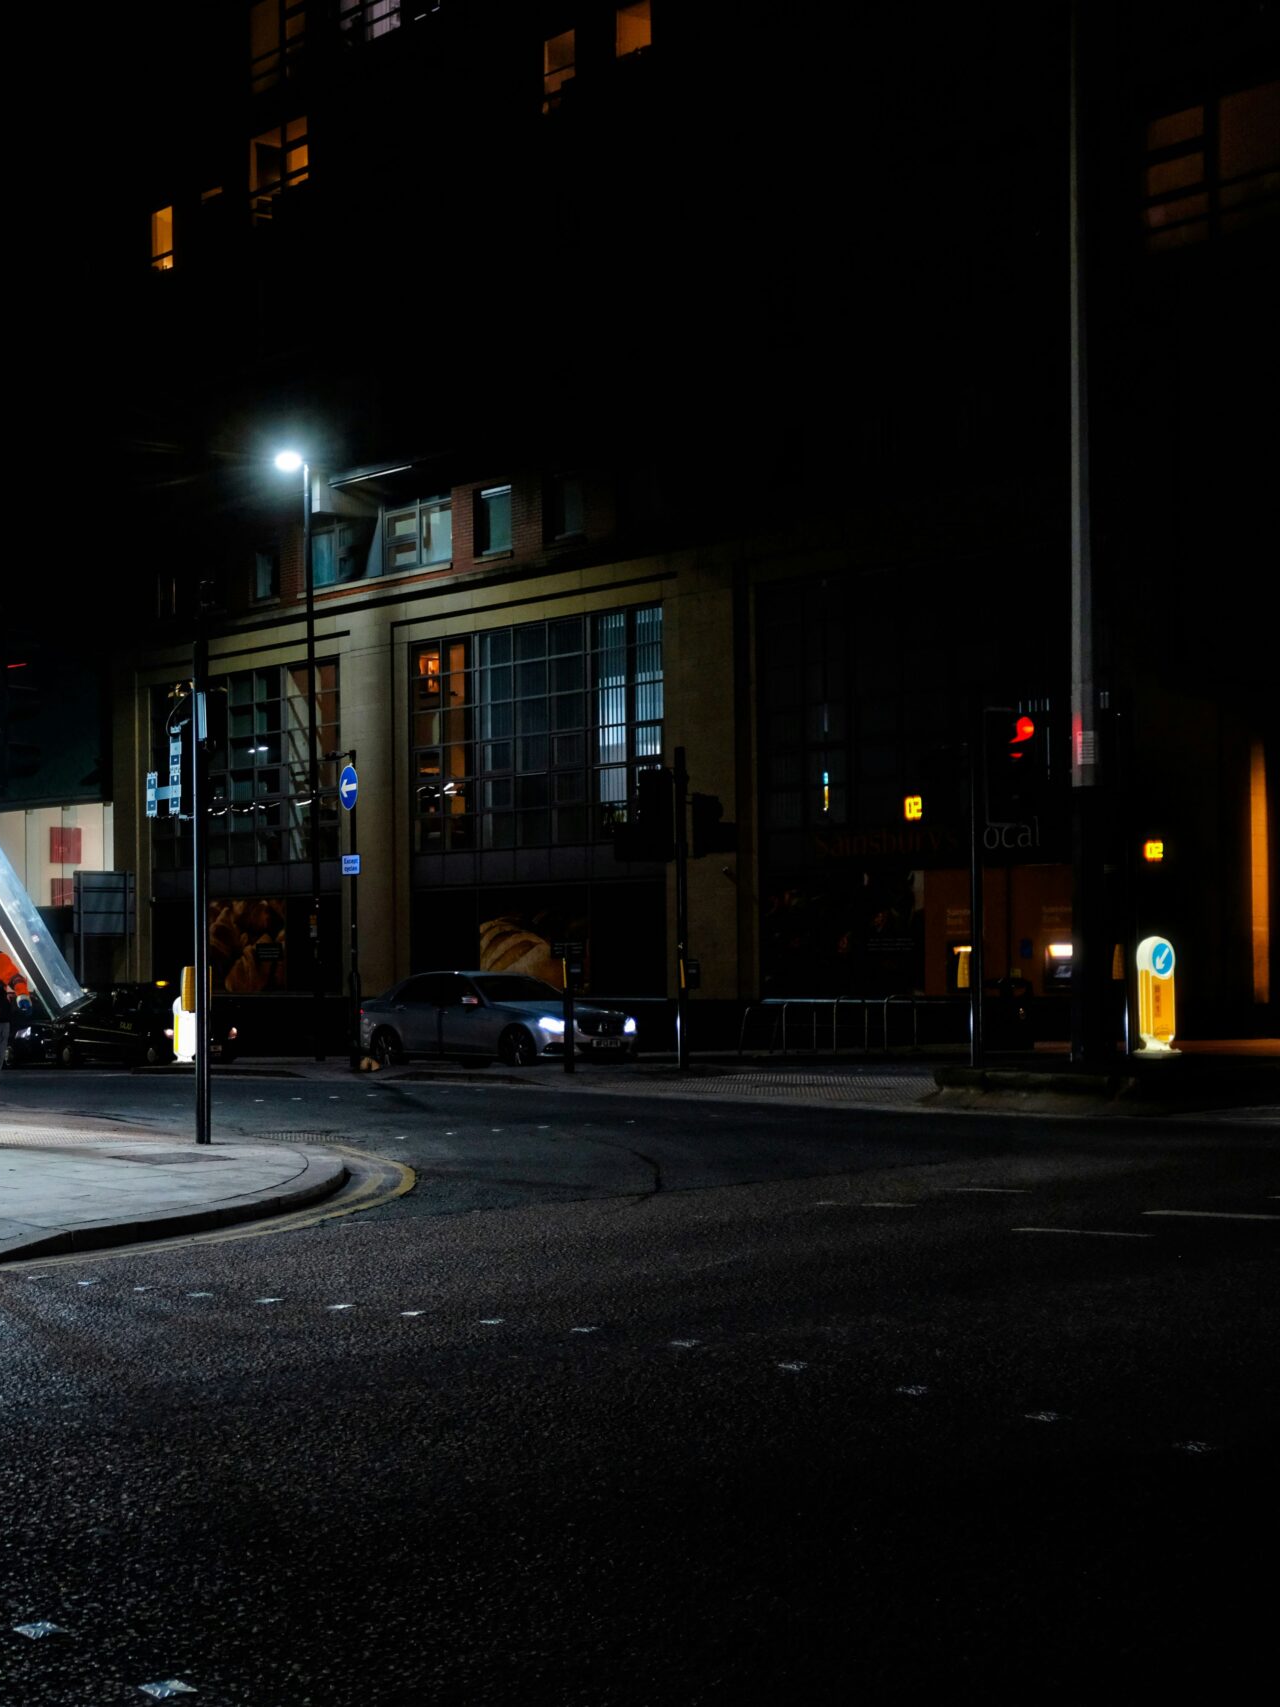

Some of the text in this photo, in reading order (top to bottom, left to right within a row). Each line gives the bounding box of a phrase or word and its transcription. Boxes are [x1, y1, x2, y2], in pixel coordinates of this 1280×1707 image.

[904, 795, 922, 820] 02
[983, 816, 1041, 849] ocal
[1145, 841, 1163, 860] 02
